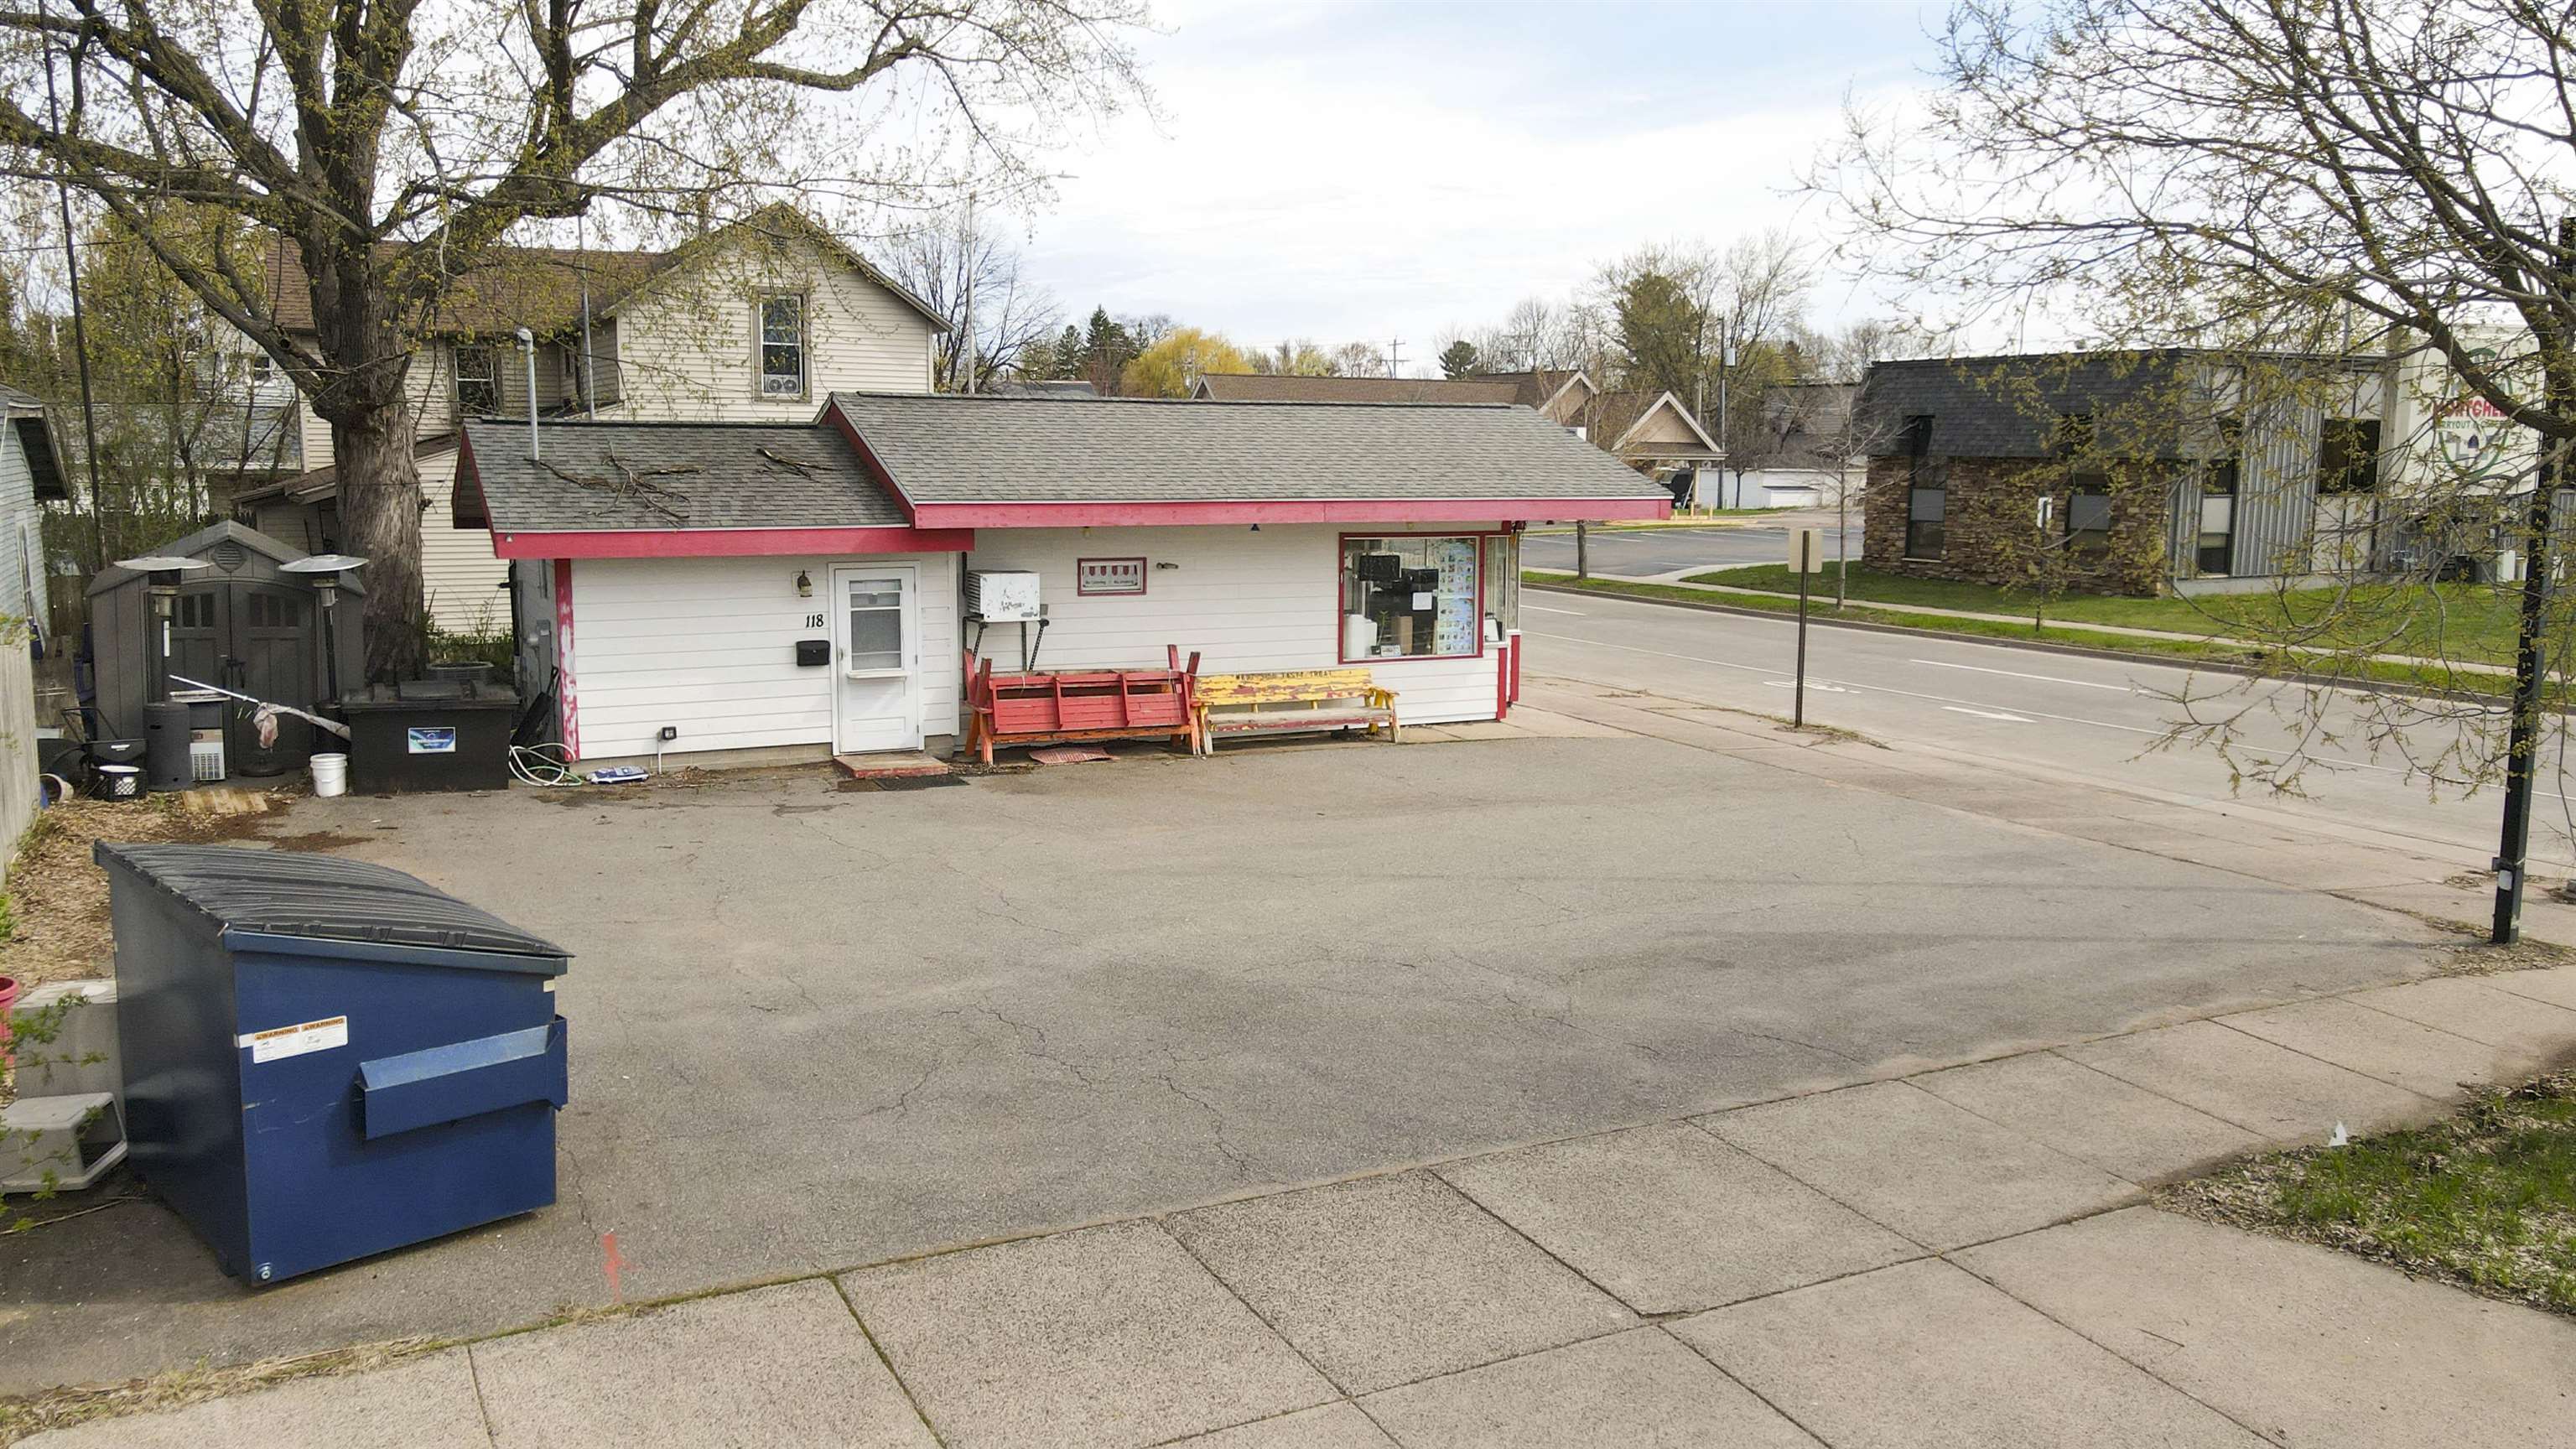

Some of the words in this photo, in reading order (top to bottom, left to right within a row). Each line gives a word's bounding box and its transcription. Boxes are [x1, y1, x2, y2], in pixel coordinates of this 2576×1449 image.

[806, 614, 823, 628] 118
[308, 1018, 344, 1029] WARNING
[261, 1027, 298, 1038] WARNING
